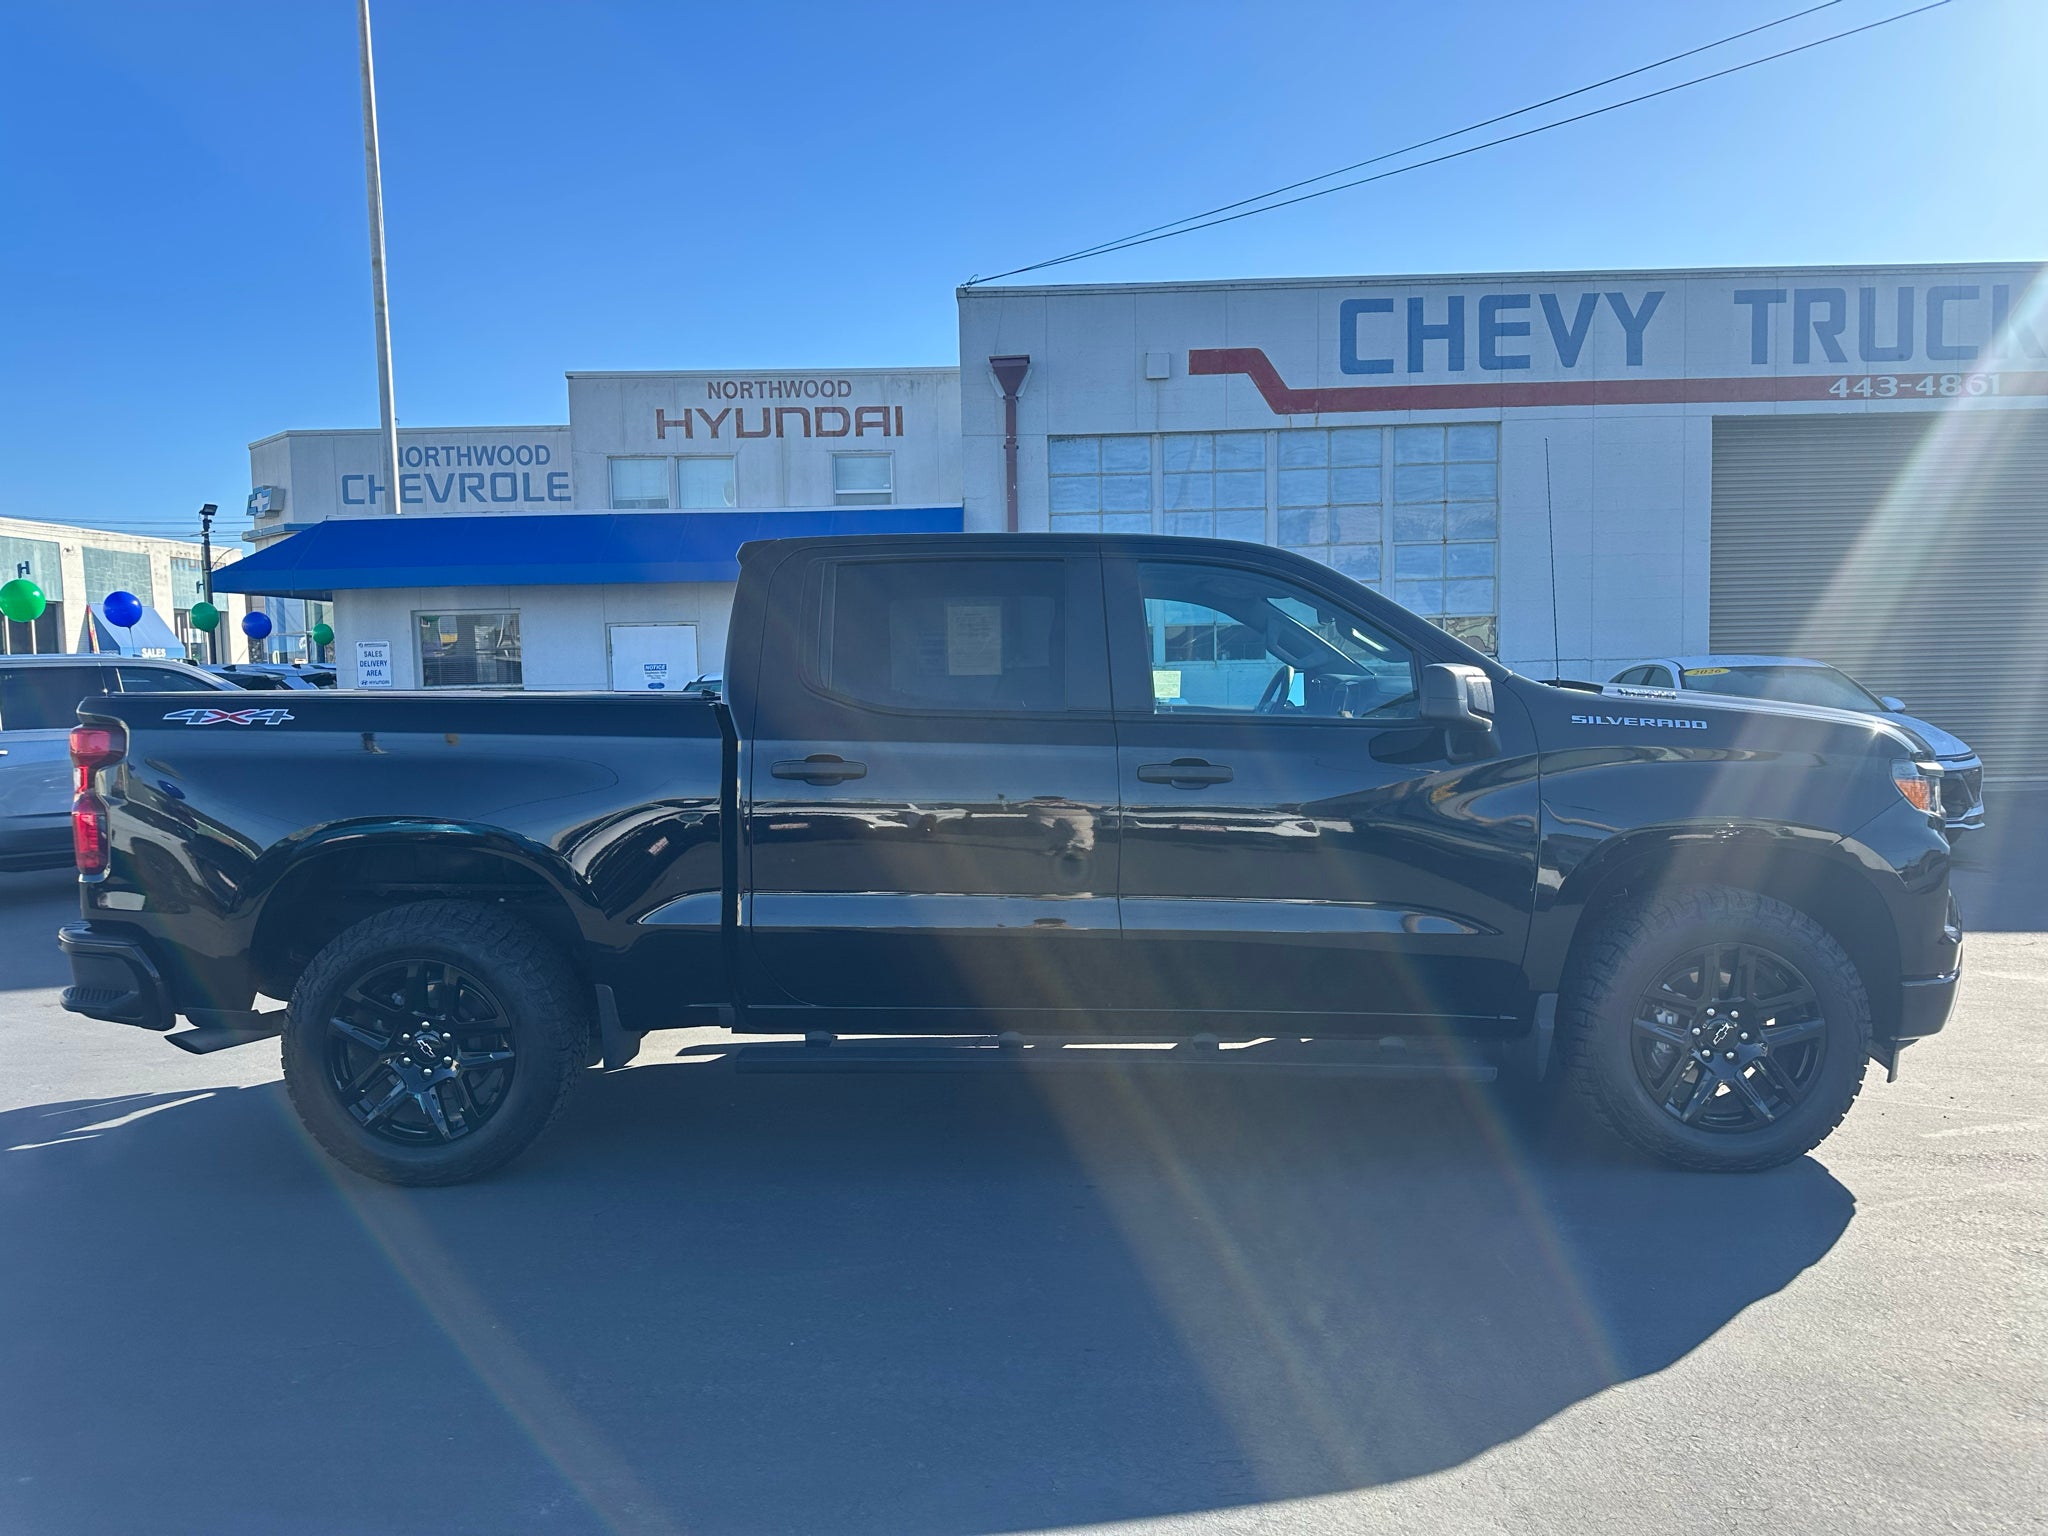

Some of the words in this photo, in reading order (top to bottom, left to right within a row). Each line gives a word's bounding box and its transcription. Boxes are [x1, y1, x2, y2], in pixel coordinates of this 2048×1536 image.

[1340, 291, 1666, 375] CHEVY
[707, 380, 852, 399] NORTHWOOD
[1828, 373, 2001, 398] 443-4861
[656, 406, 904, 439] HYUNDAI
[342, 471, 572, 504] CHEVROLE
[141, 647, 166, 658] SALES
[363, 650, 383, 658] SALES
[360, 660, 388, 668] DELIVERY
[366, 669, 382, 677] AREA
[1571, 714, 1708, 730] SILVERADO
